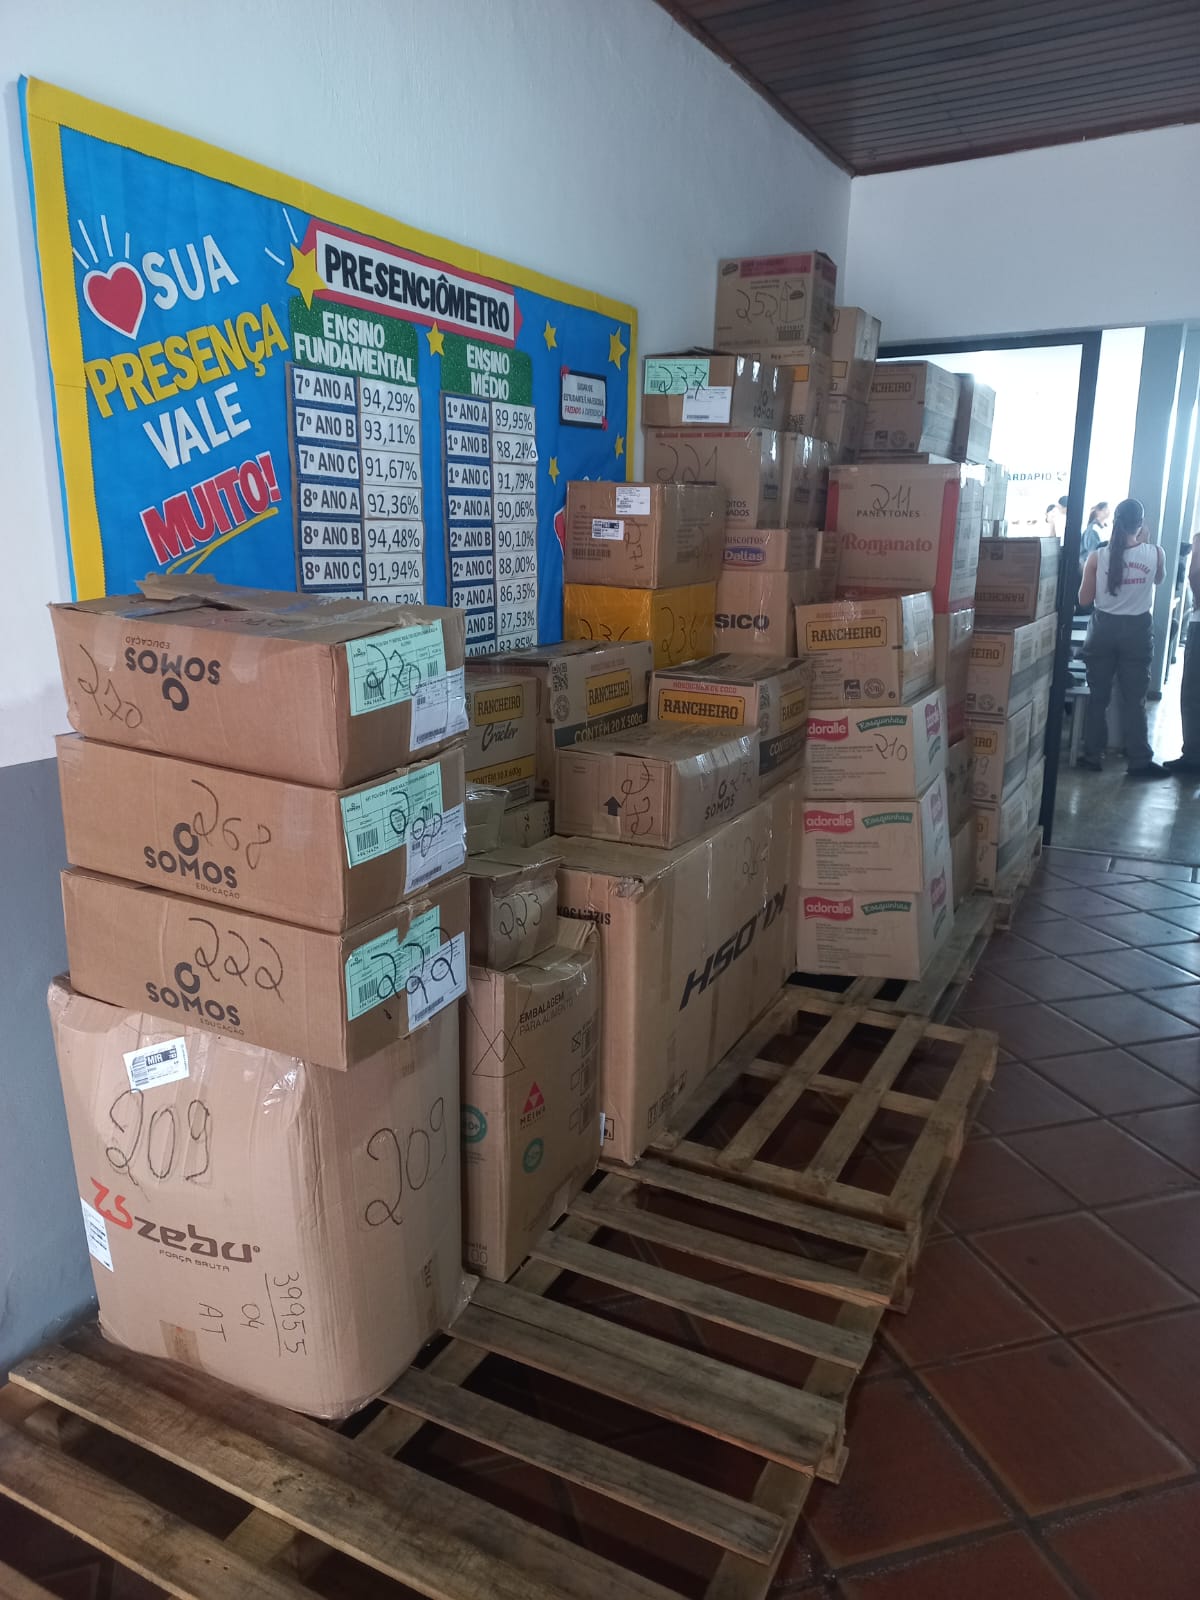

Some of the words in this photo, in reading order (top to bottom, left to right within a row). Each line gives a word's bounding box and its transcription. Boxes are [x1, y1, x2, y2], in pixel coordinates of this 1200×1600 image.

[142, 234, 239, 310] SUA
[324, 243, 510, 333] PRESENCIÔMETRO
[736, 289, 778, 324] 252
[322, 311, 385, 349] ENSINO
[84, 302, 288, 419] PRESENÇA
[293, 332, 416, 384] FUNDAMENTAL
[466, 343, 510, 375] ENSINO
[295, 374, 310, 394] 7º
[313, 376, 341, 400] ANO
[344, 382, 353, 401] A
[470, 372, 510, 401] MÉDIO
[658, 365, 707, 401] 237
[362, 387, 415, 414] 94,29%
[460, 403, 480, 422] ANO
[481, 405, 488, 422] A
[142, 381, 251, 469] VALE
[297, 412, 312, 433] 7º
[315, 414, 342, 436] ANO
[345, 418, 355, 438] B
[364, 419, 416, 445] 93,11%
[495, 409, 533, 431] 89,95%
[461, 436, 481, 453] ANO
[481, 437, 488, 454] B
[300, 449, 315, 470] 7º
[318, 452, 345, 473] ANO
[348, 455, 357, 474] C
[365, 456, 417, 481] 91,67%
[461, 468, 481, 485] ANO
[483, 469, 489, 485] C
[497, 471, 534, 491] 91,79%
[139, 451, 282, 566] MUITO!
[303, 488, 318, 508] 8º
[321, 489, 347, 509] ANO
[349, 491, 359, 511] A
[367, 493, 419, 517] 92,36%
[463, 500, 482, 516] ANO
[483, 500, 490, 516] A
[870, 483, 912, 511] 211
[497, 500, 534, 522] 90,06%
[857, 509, 921, 518] PANETTONES
[303, 525, 319, 545] 8º
[322, 526, 348, 545] ANO
[351, 527, 360, 546] B
[367, 528, 420, 552] 94,48%
[464, 530, 483, 546] ANO
[484, 530, 491, 545] B
[498, 529, 534, 549] 90,10%
[843, 532, 932, 557] Romanato
[499, 556, 535, 577] 88,00%
[724, 549, 763, 561] Dallas
[305, 561, 320, 580] 8º
[324, 562, 349, 580] ANO
[352, 560, 361, 579] C
[368, 559, 420, 584] 91,94%
[465, 560, 485, 577] ANO
[486, 559, 492, 575] C
[466, 589, 485, 606] ANO
[486, 588, 493, 604] A
[500, 585, 535, 604] 86,35%
[467, 617, 487, 634] ANO
[487, 615, 494, 631] B
[500, 613, 535, 632] 87,53%
[661, 606, 697, 658] 236
[715, 613, 770, 631] SICO
[812, 626, 881, 642] RANCHEIRO
[125, 635, 172, 650] EDUCAÇÃO
[469, 644, 488, 656] ANO
[488, 643, 494, 654] C
[124, 646, 221, 685] SOMOS
[366, 643, 422, 700] 270
[77, 643, 143, 729] 270
[589, 680, 629, 705] RANCHEIRO
[478, 694, 521, 716] RANCHEIRO
[663, 698, 738, 720] RANCHEIRO
[574, 721, 610, 744] CONTÉM
[610, 720, 619, 732] 20
[621, 717, 626, 728] X
[808, 720, 847, 735] doralle
[873, 733, 908, 761] 210
[705, 794, 735, 821] SOMOS
[192, 779, 271, 870] 268
[805, 815, 853, 827] adoralle
[143, 845, 238, 889] SOMOS
[195, 882, 240, 900] EDUCAÇÃO
[499, 893, 543, 941] 223
[805, 901, 852, 915] adoralle
[188, 917, 284, 1002] 222
[370, 926, 457, 1004] 222
[145, 982, 241, 1027] SOMOS
[519, 991, 564, 1024] EMBALAGEM
[200, 1017, 245, 1036] EDUCAÇÃO
[519, 1018, 541, 1035] PARA
[105, 1087, 213, 1188] 209
[364, 1097, 449, 1227] 209
[133, 1216, 253, 1264] zebu
[159, 1249, 193, 1266] FORÇA
[195, 1258, 230, 1273] BRUTA
[198, 1302, 228, 1343] AT
[273, 1271, 307, 1357] 39955
